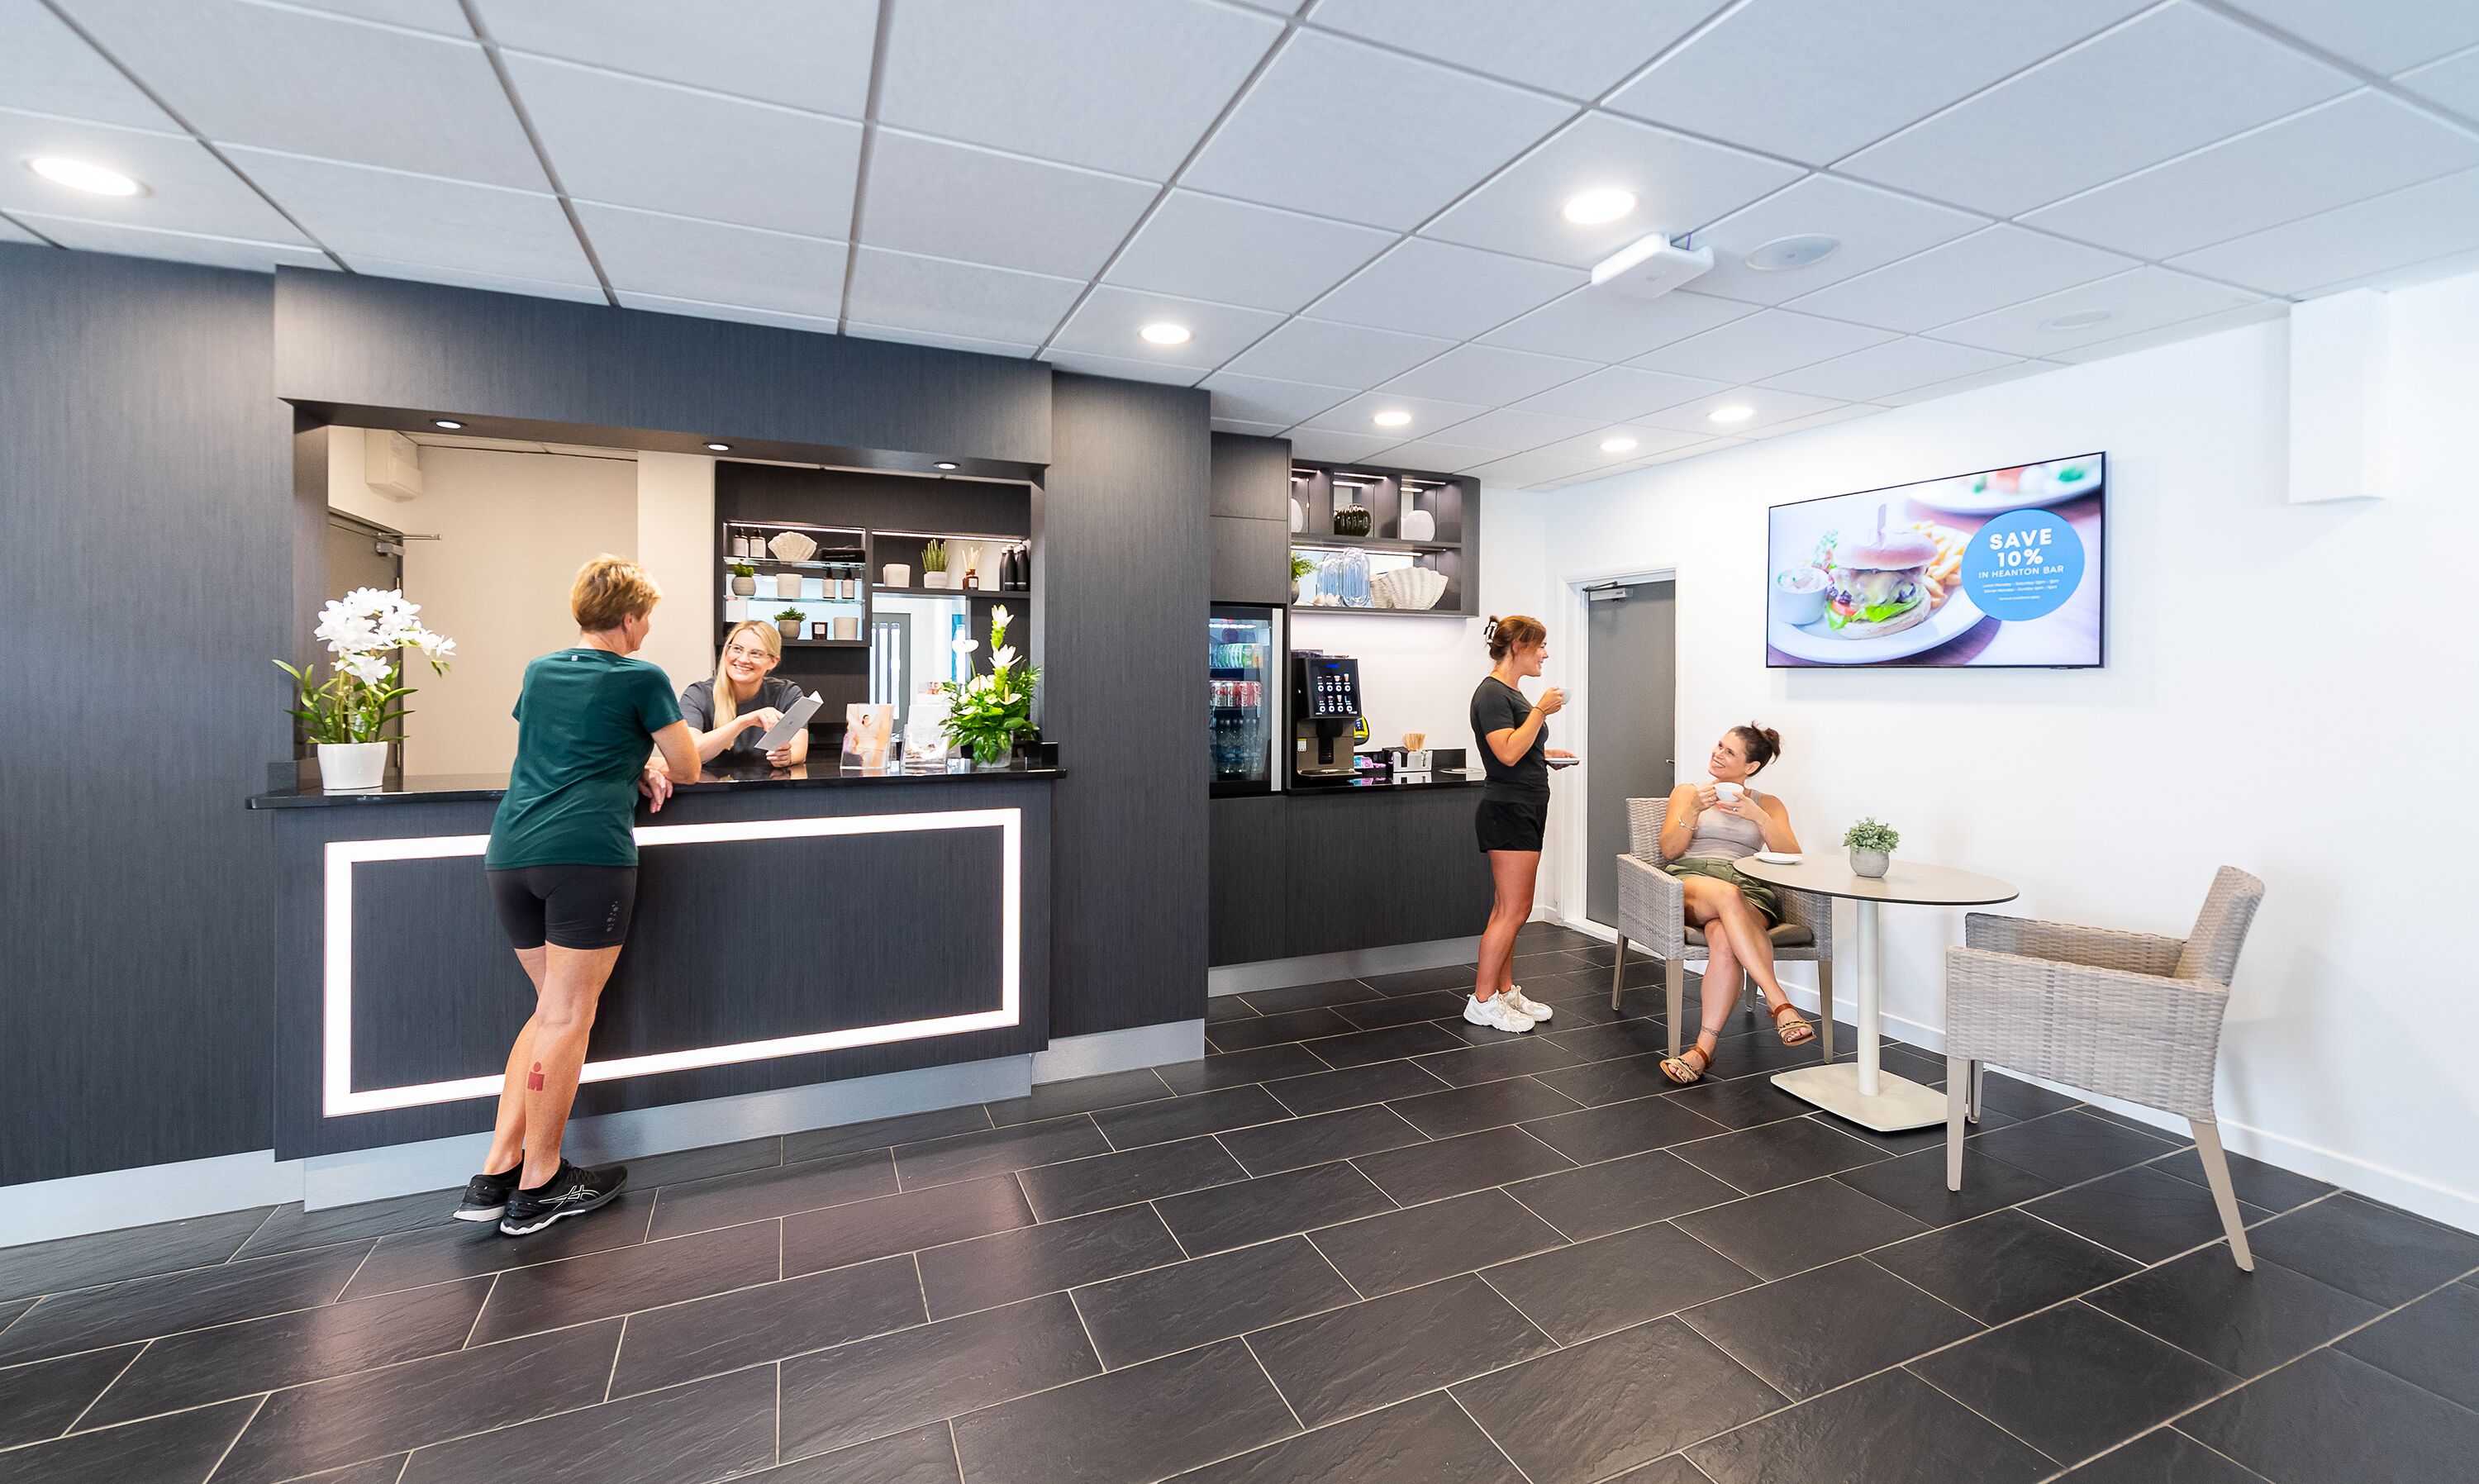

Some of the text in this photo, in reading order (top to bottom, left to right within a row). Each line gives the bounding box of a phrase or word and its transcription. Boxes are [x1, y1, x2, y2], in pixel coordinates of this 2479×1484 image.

[1989, 527, 2053, 550] SAVE
[1996, 548, 2044, 568] 10%
[1978, 564, 2064, 579] IN HEANTON BAR
